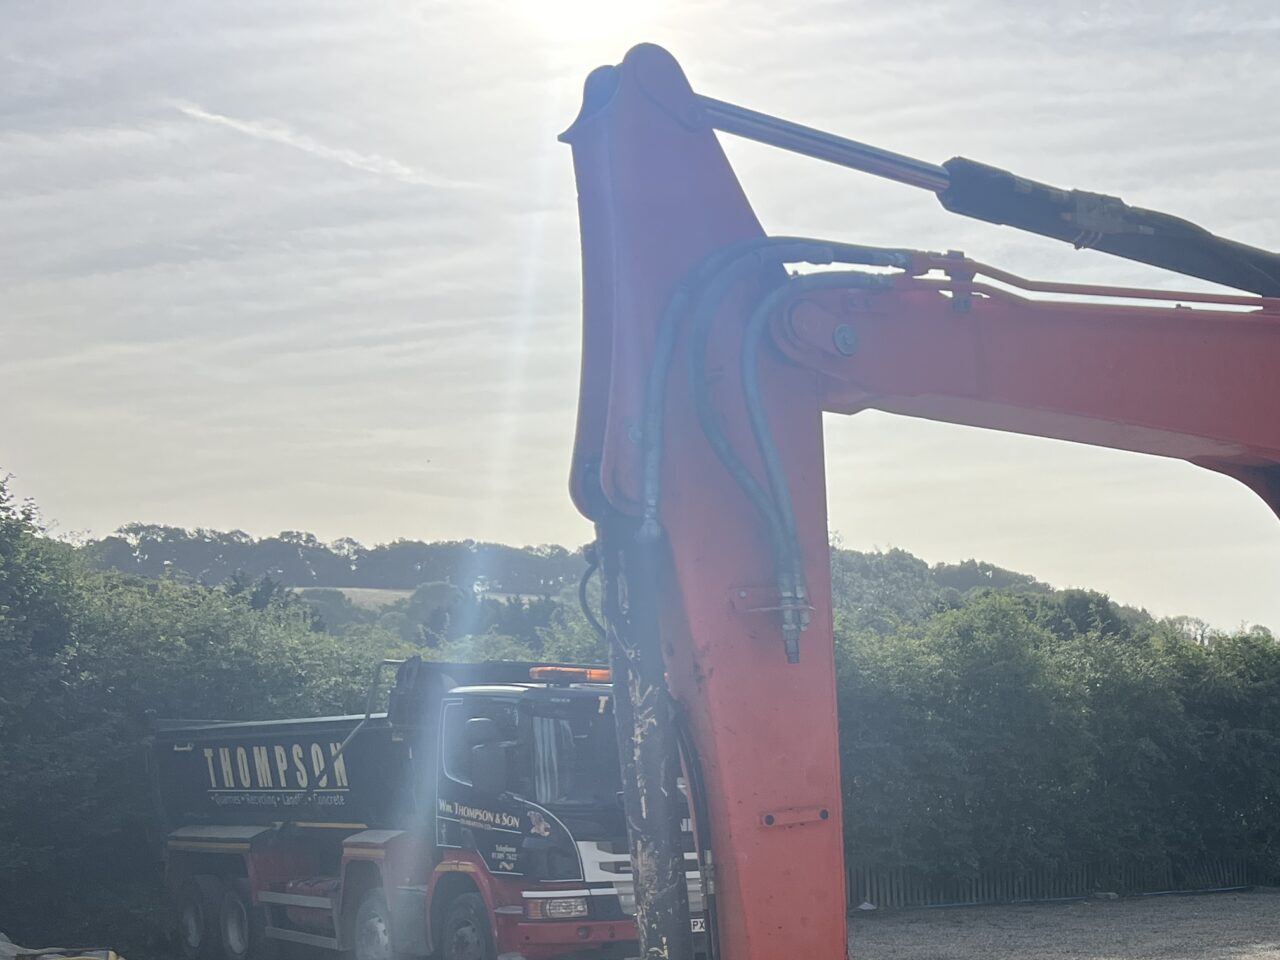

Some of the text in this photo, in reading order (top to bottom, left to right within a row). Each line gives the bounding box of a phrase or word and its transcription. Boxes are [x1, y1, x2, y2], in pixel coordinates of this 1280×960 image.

[204, 743, 348, 788] THOMPSON
[455, 802, 493, 823] THOMPSON
[495, 812, 501, 824] &
[502, 812, 520, 828] SON
